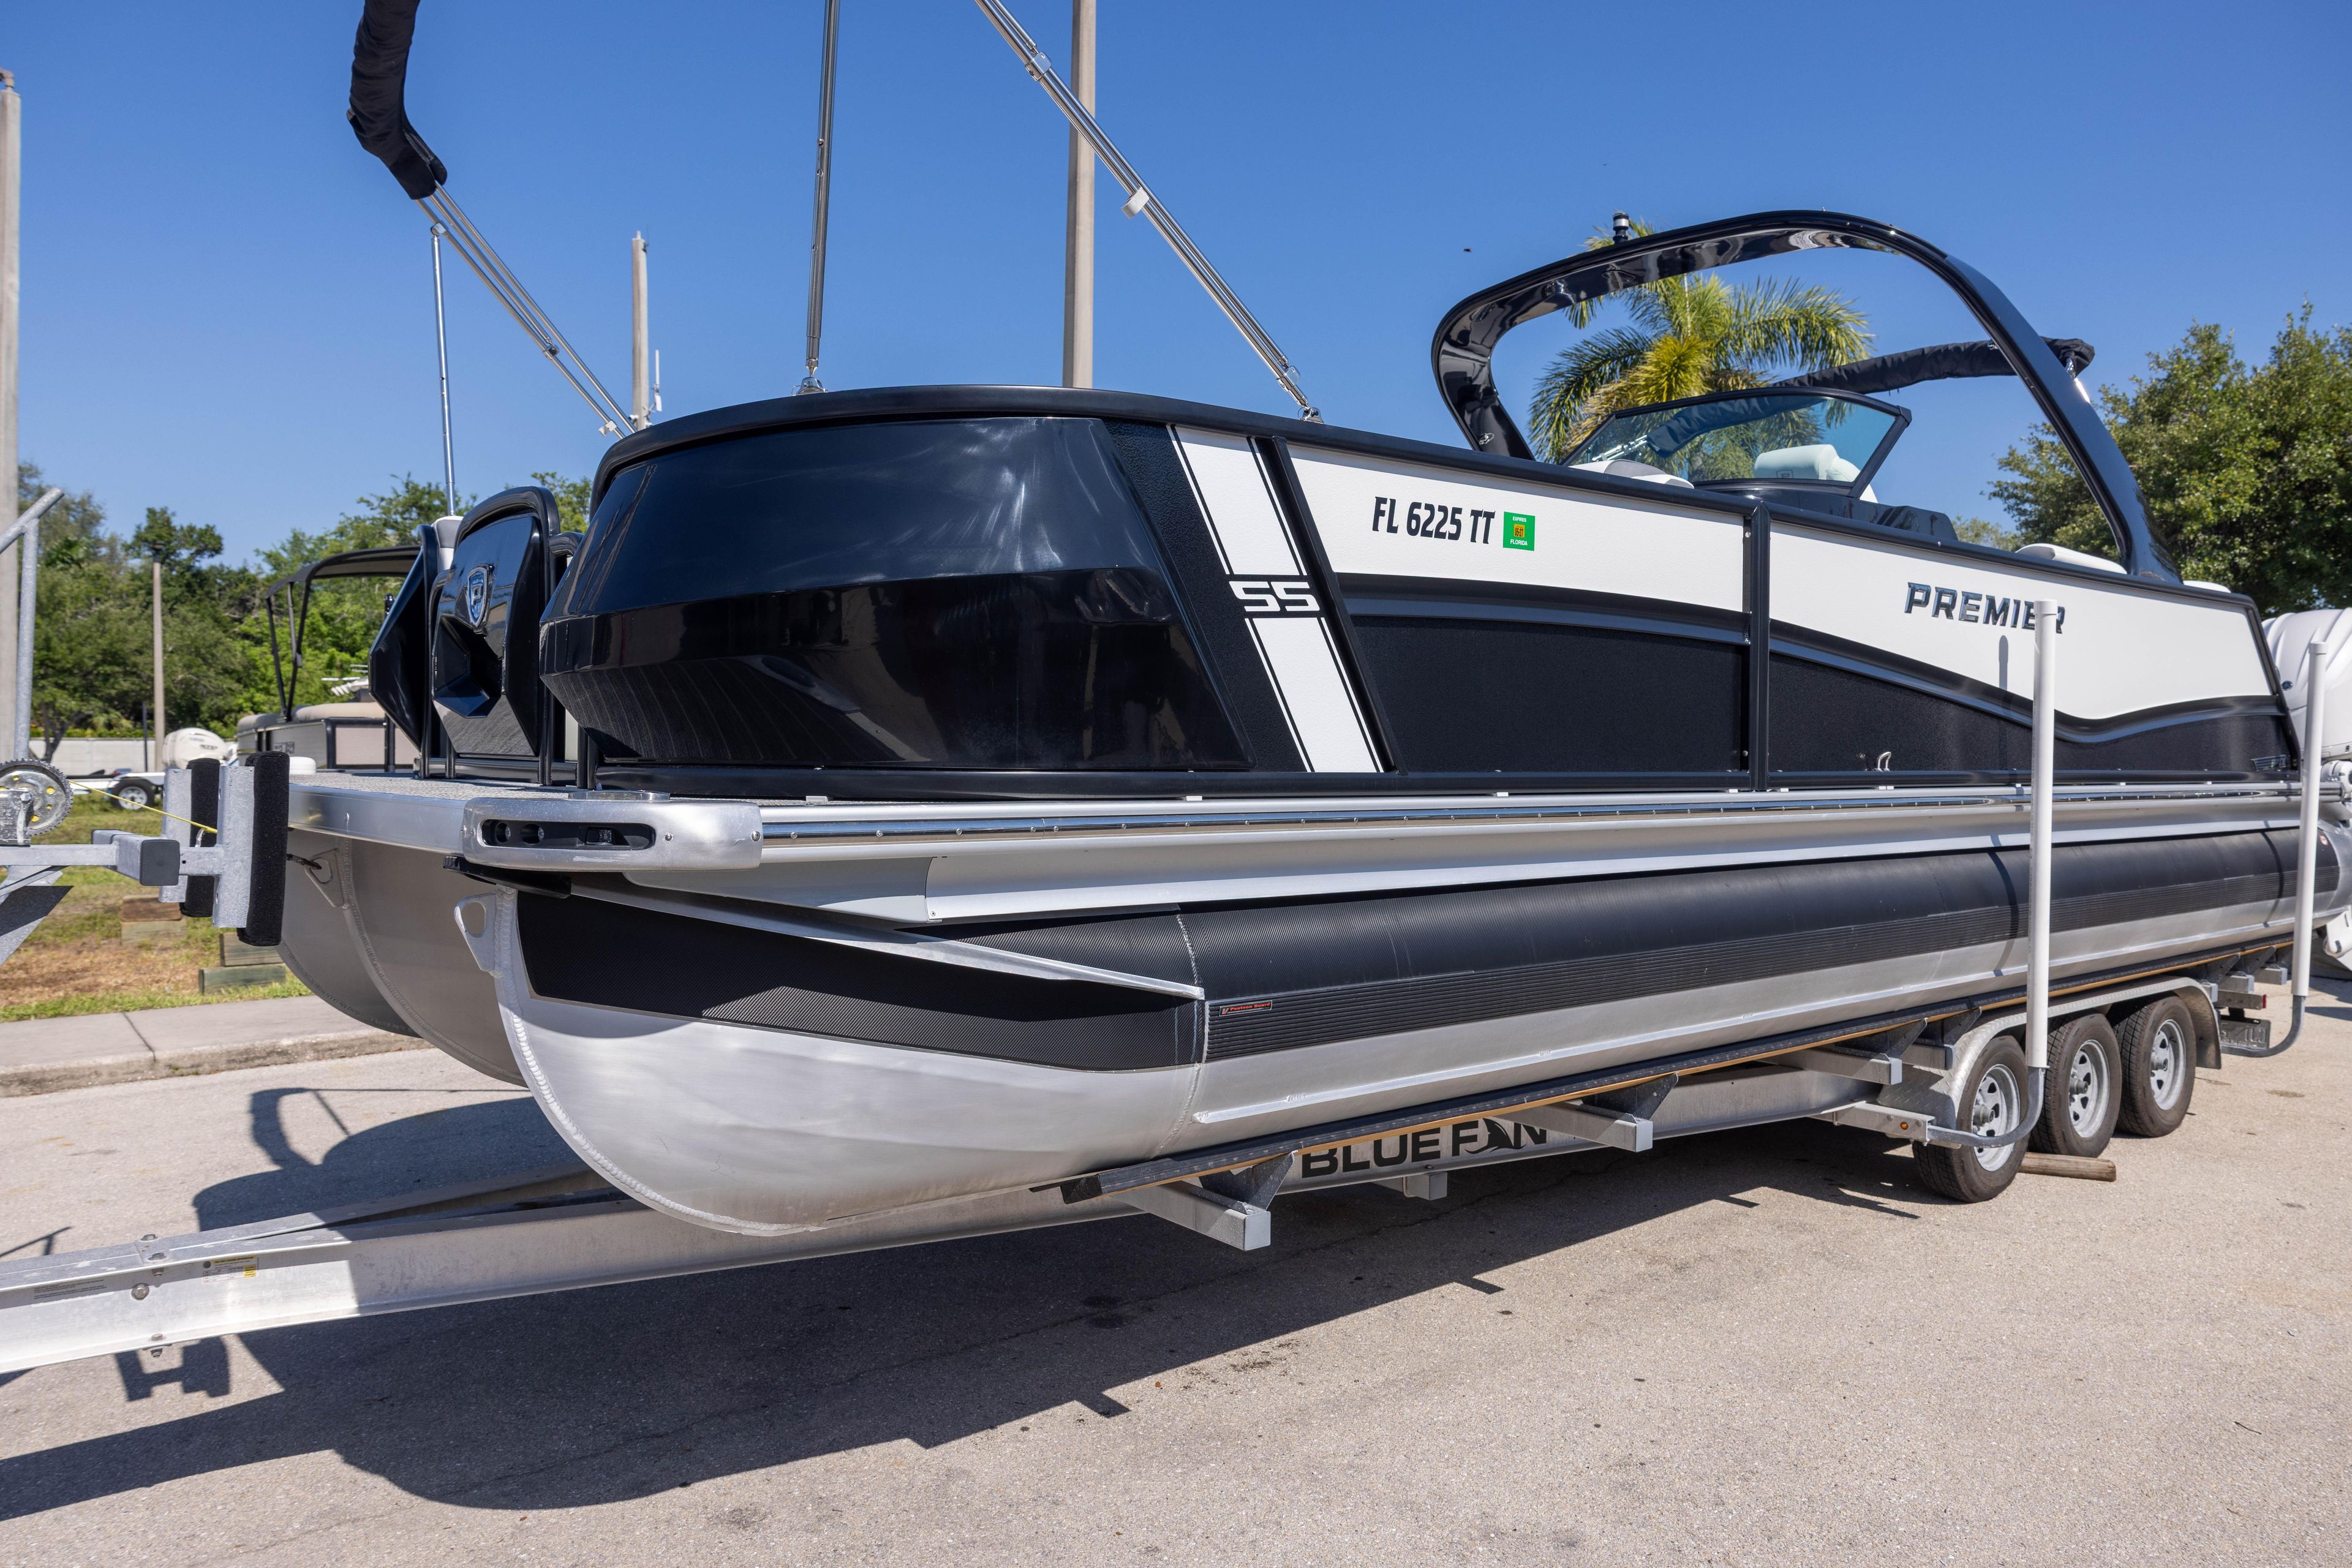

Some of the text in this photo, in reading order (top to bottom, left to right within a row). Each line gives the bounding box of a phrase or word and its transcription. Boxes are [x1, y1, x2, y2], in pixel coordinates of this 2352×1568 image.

[1372, 496, 1496, 544] FL 6225 TT
[1229, 581, 1320, 612] SS
